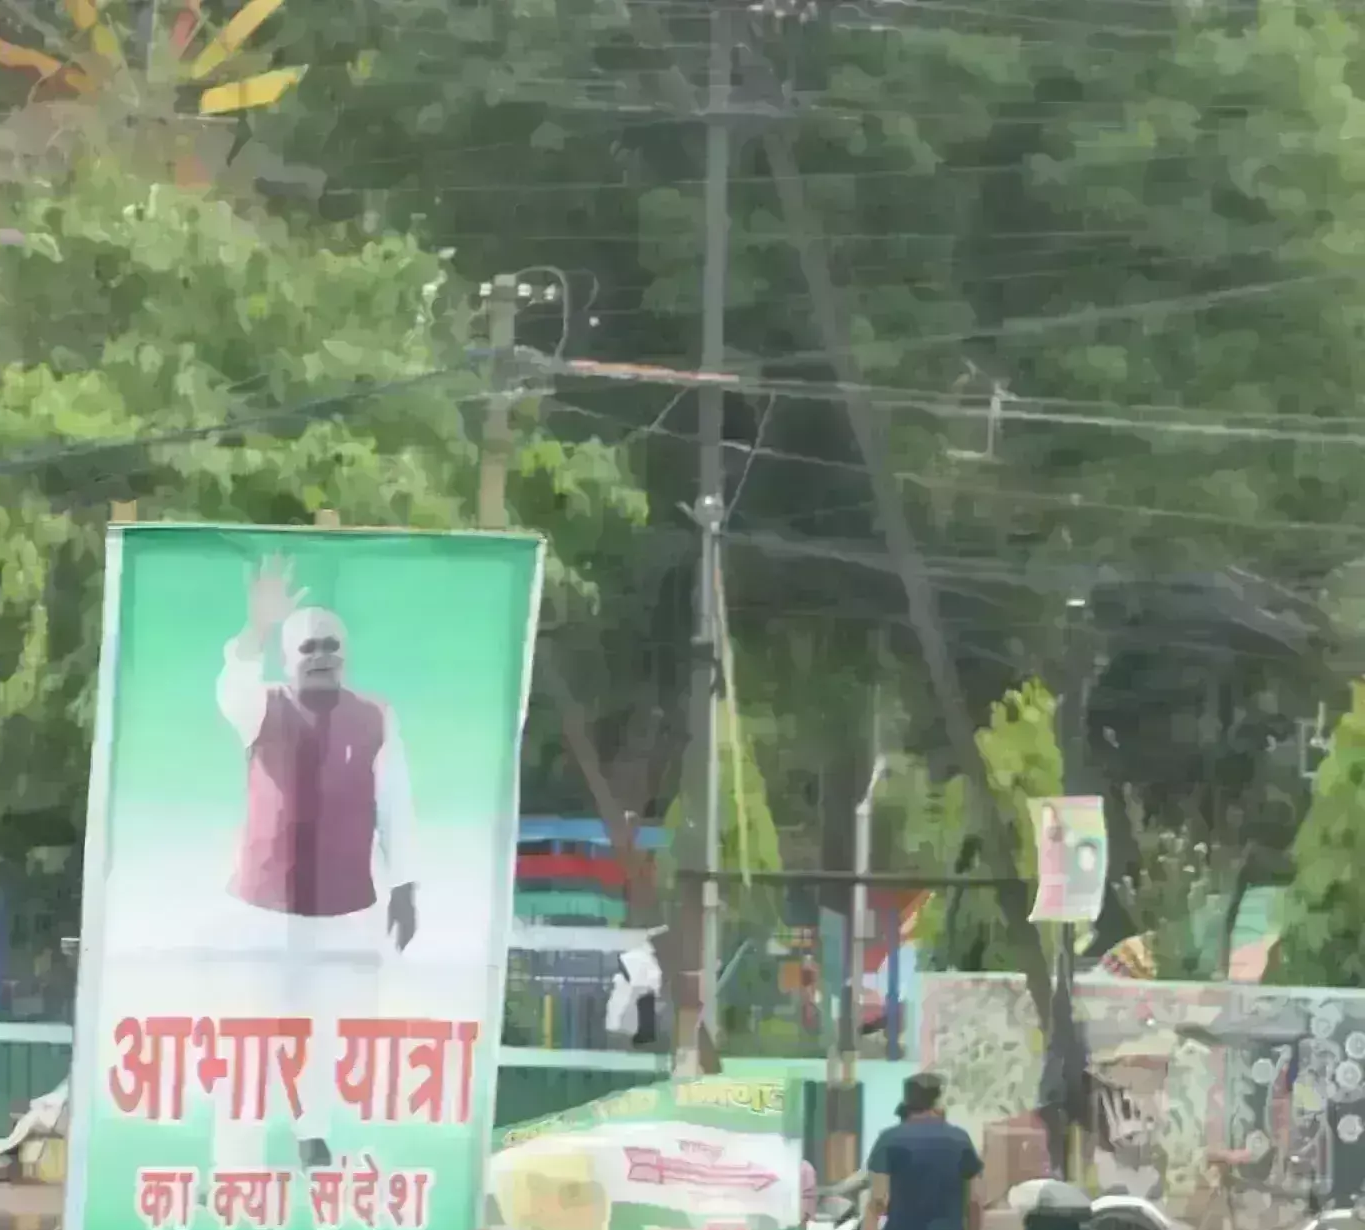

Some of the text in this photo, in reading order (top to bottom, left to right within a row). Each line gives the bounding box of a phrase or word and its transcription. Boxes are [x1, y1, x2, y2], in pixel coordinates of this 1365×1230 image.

[108, 1016, 479, 1123] आभार यात्रा
[140, 1154, 428, 1227] का क्या संदेश
